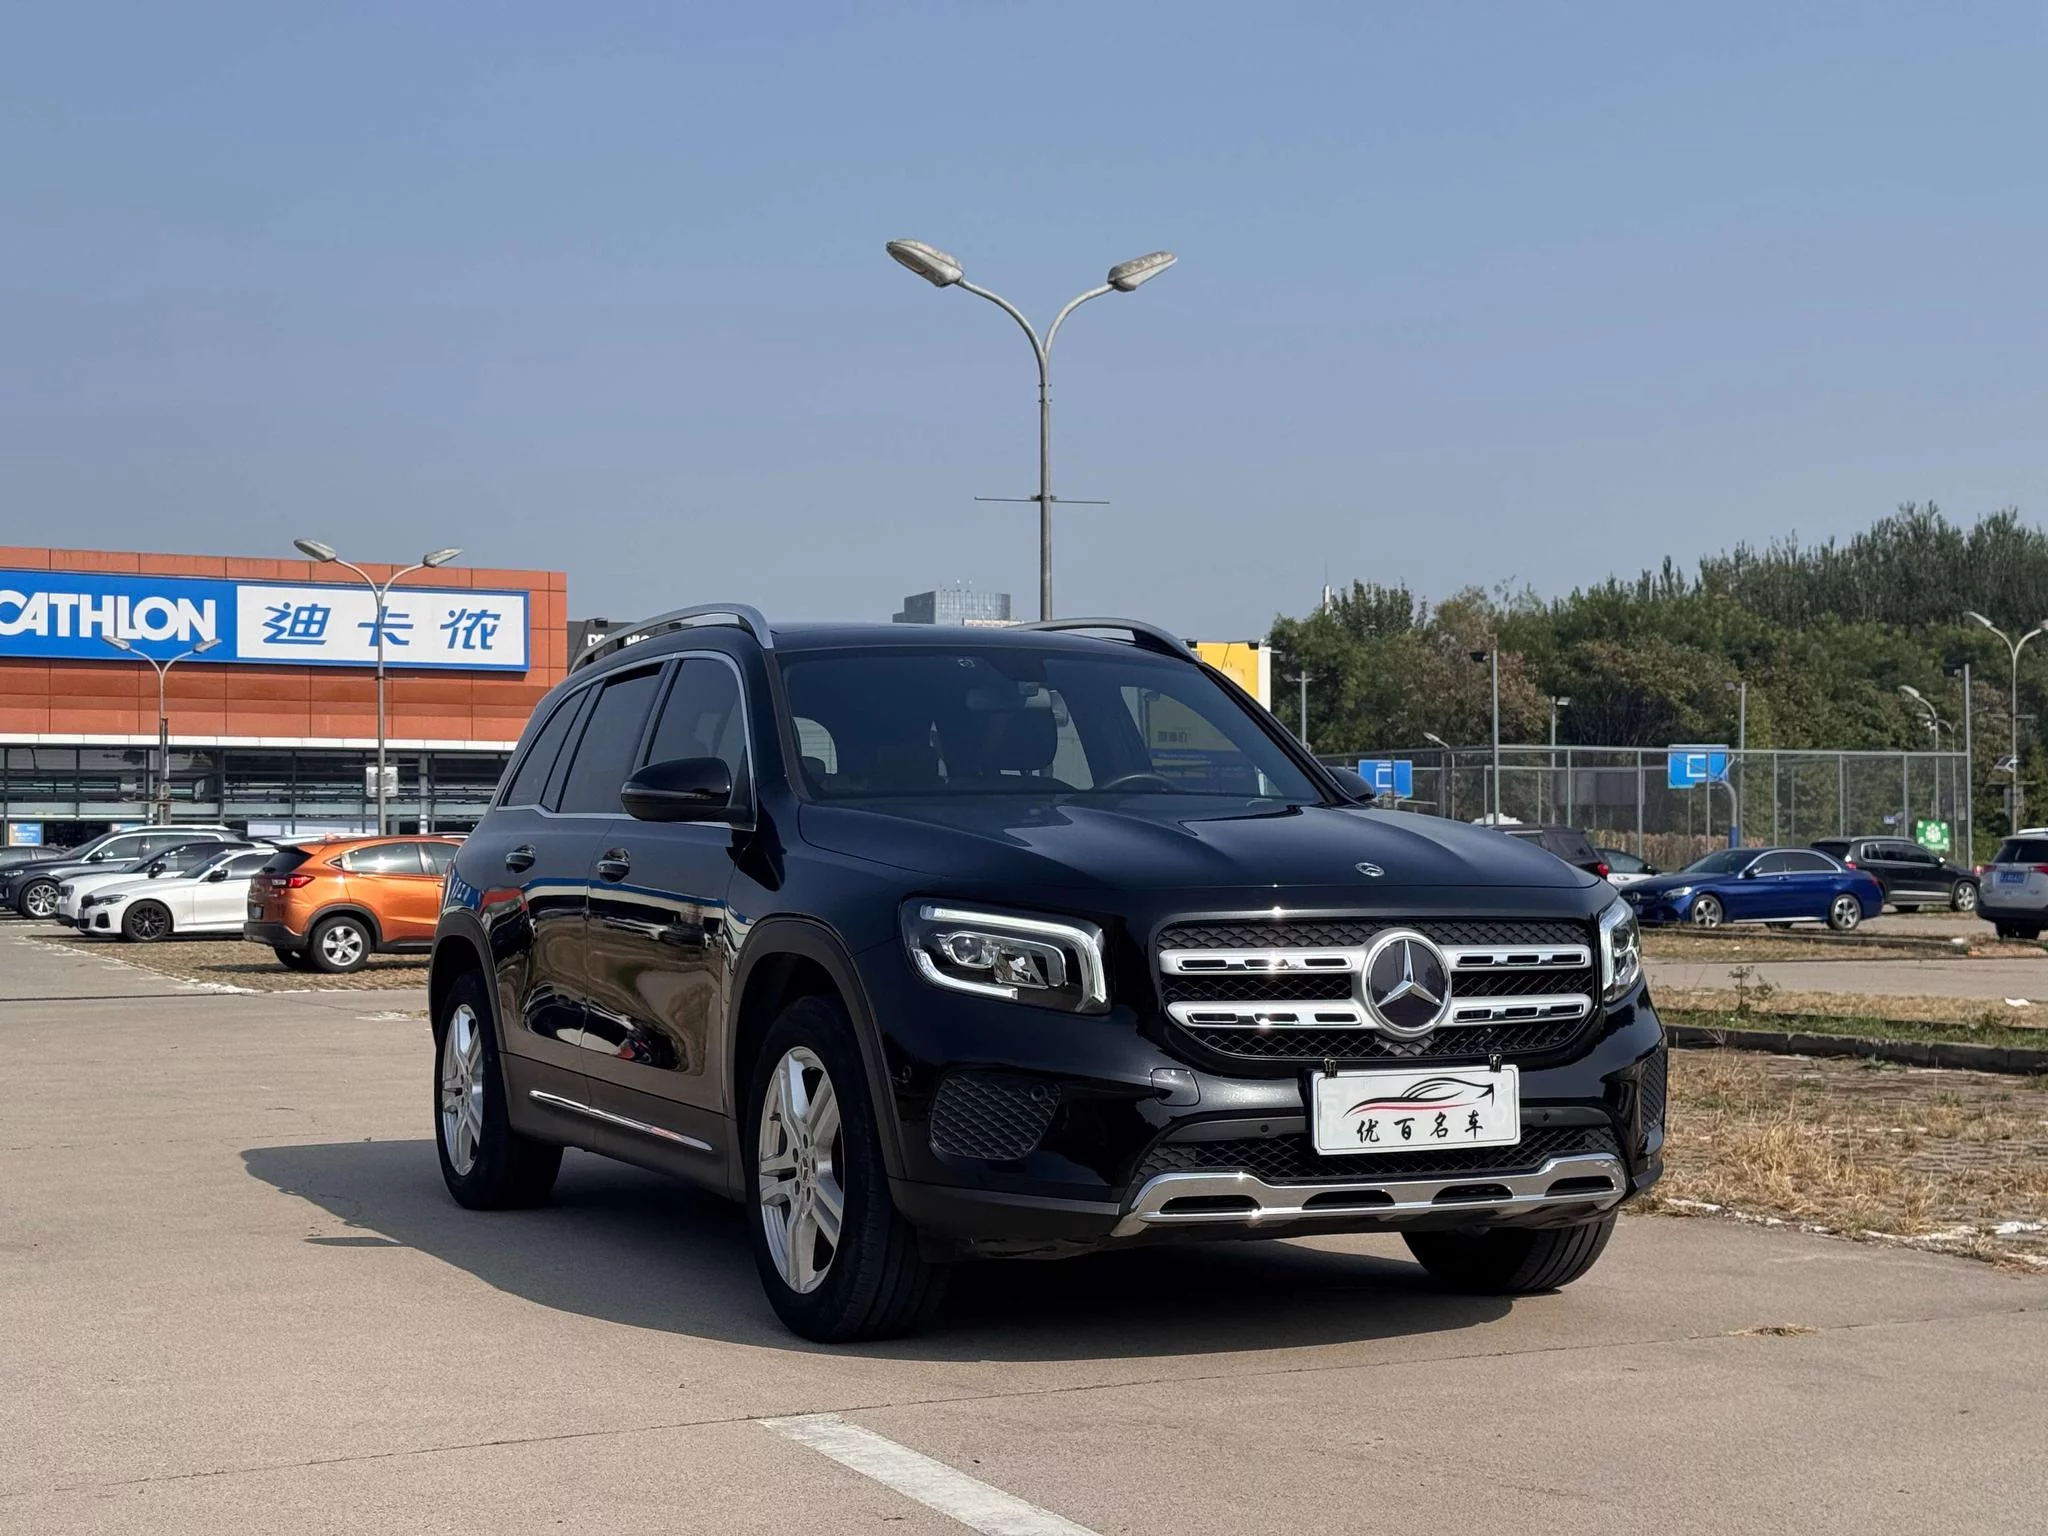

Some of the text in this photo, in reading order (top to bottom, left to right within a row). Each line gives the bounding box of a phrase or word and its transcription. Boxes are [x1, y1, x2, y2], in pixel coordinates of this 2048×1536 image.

[0, 590, 216, 641] CATHLON
[262, 602, 501, 650] 迪卡侬
[1356, 1110, 1484, 1143] 优百名车
